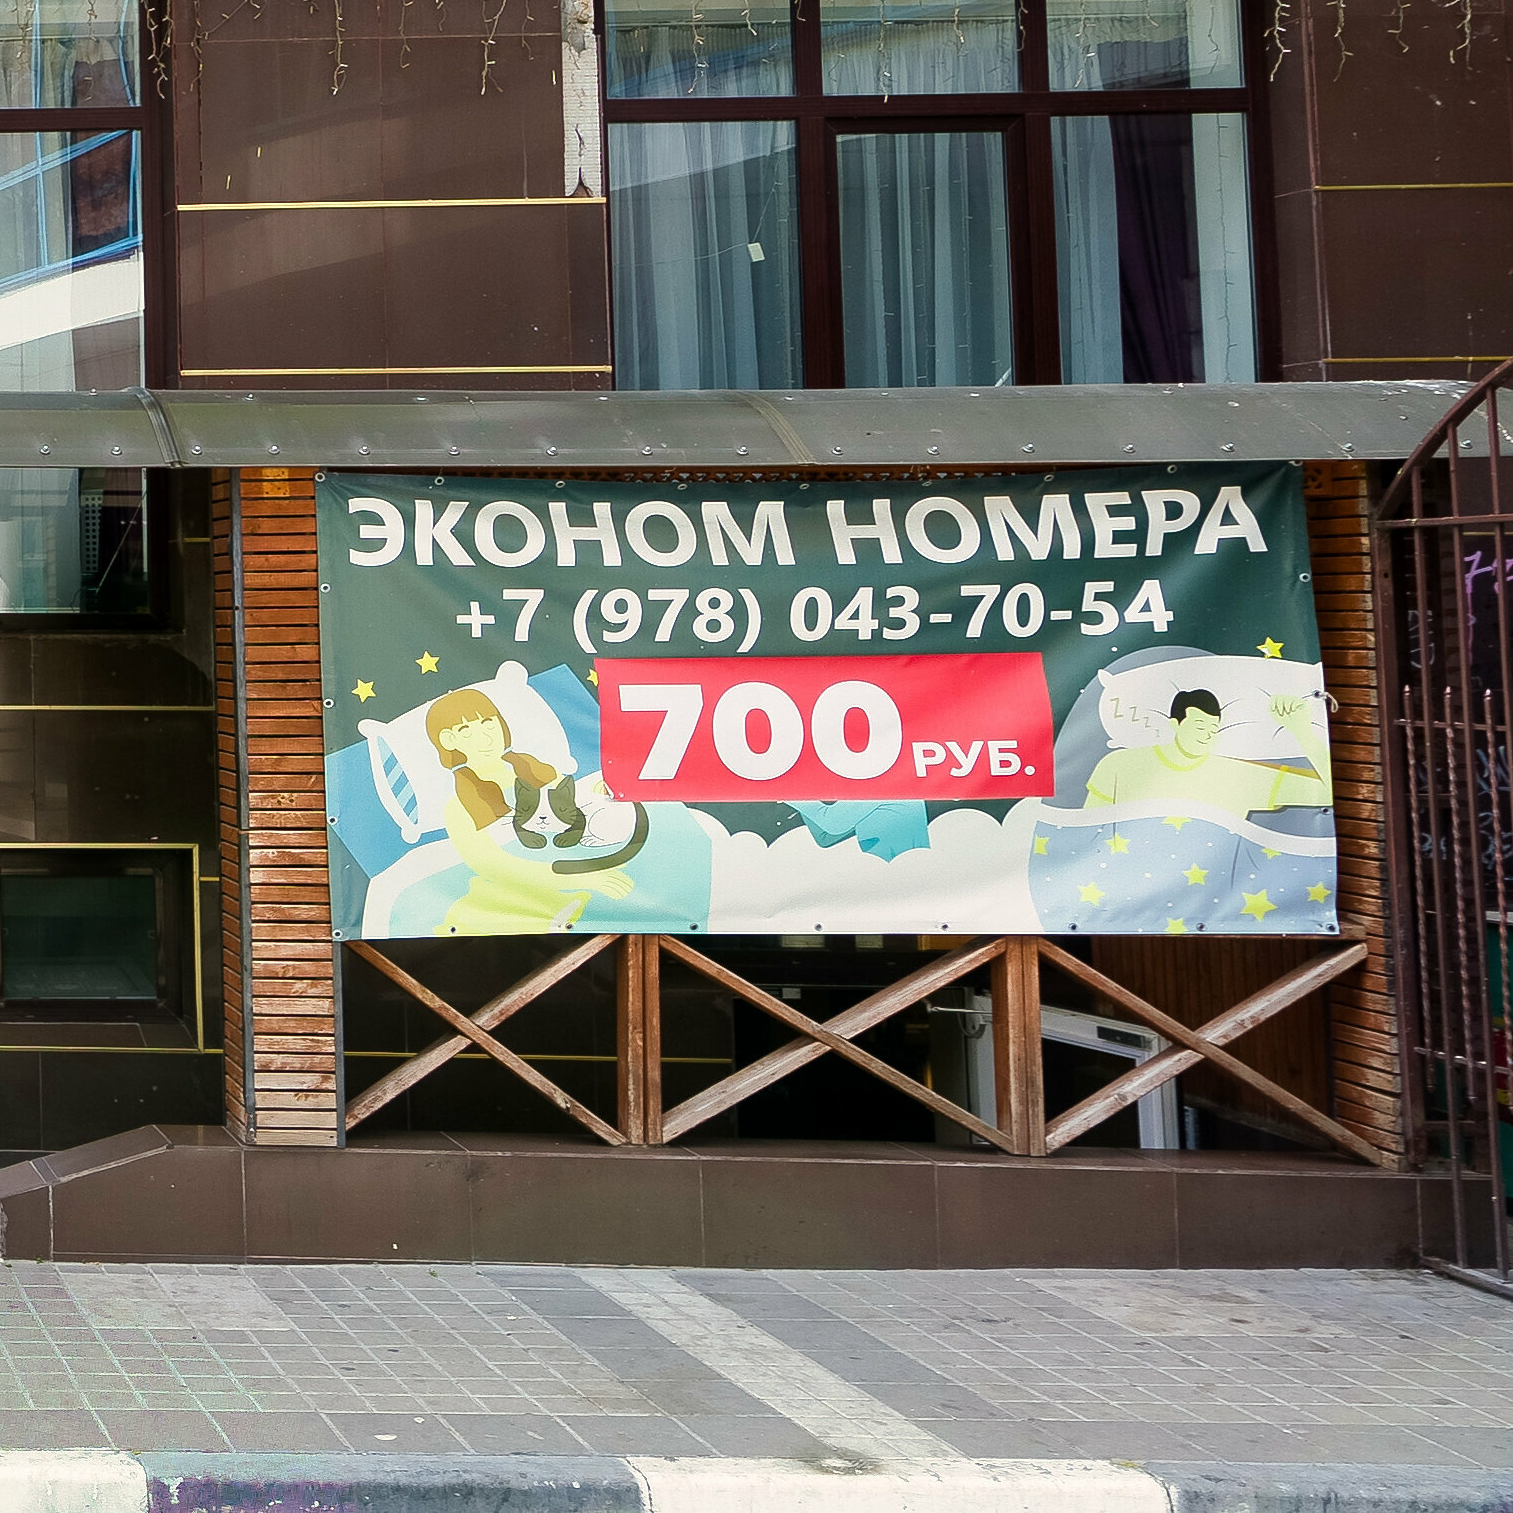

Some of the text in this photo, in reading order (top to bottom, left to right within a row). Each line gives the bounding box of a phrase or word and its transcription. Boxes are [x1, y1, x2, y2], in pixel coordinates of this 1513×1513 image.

[347, 485, 1269, 569] ЭКОНОМ НОМЕРА
[456, 579, 1174, 654] +7 (978) 043-70-54
[618, 679, 1037, 782] 700 РУБ.
